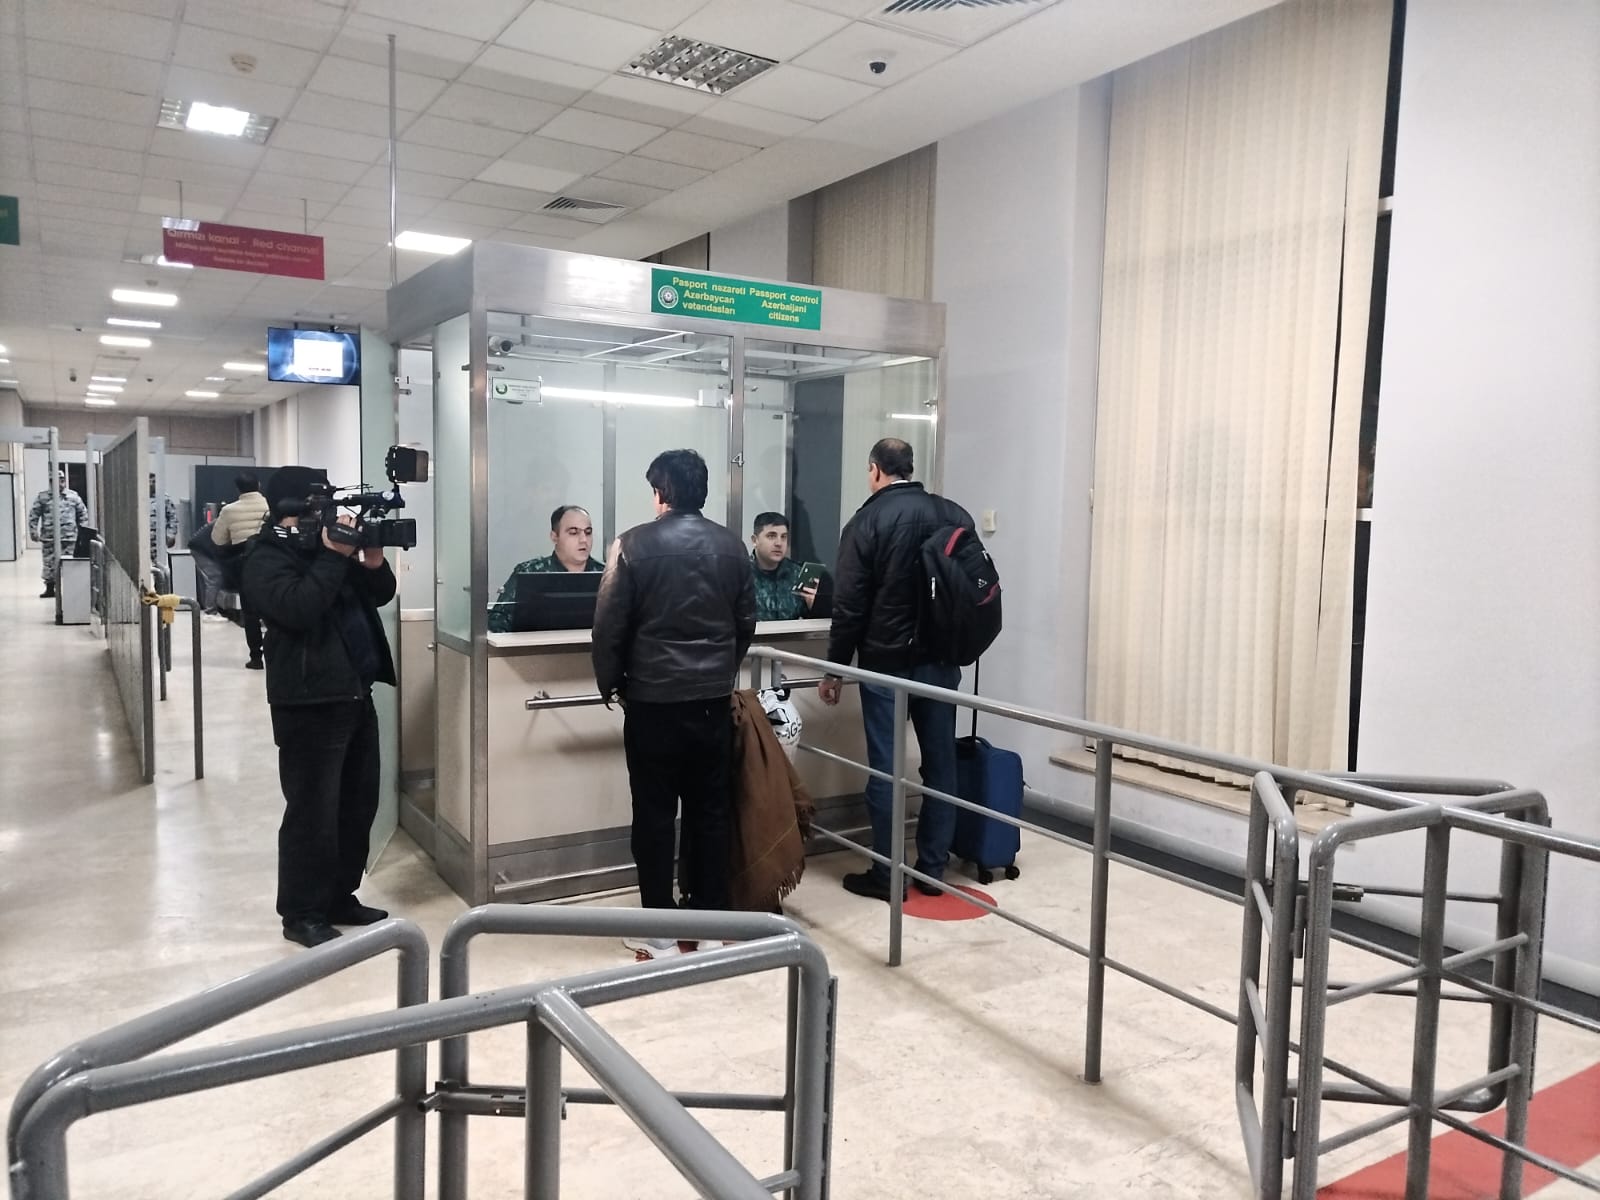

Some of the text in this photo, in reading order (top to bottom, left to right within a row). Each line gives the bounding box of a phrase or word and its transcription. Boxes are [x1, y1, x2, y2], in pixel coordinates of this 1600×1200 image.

[252, 238, 274, 248] Red
[672, 276, 708, 291] Pasport
[749, 287, 819, 305] Passport control
[761, 299, 807, 314] Azerbaijani
[768, 312, 800, 323] citizens
[731, 452, 745, 467] 4
